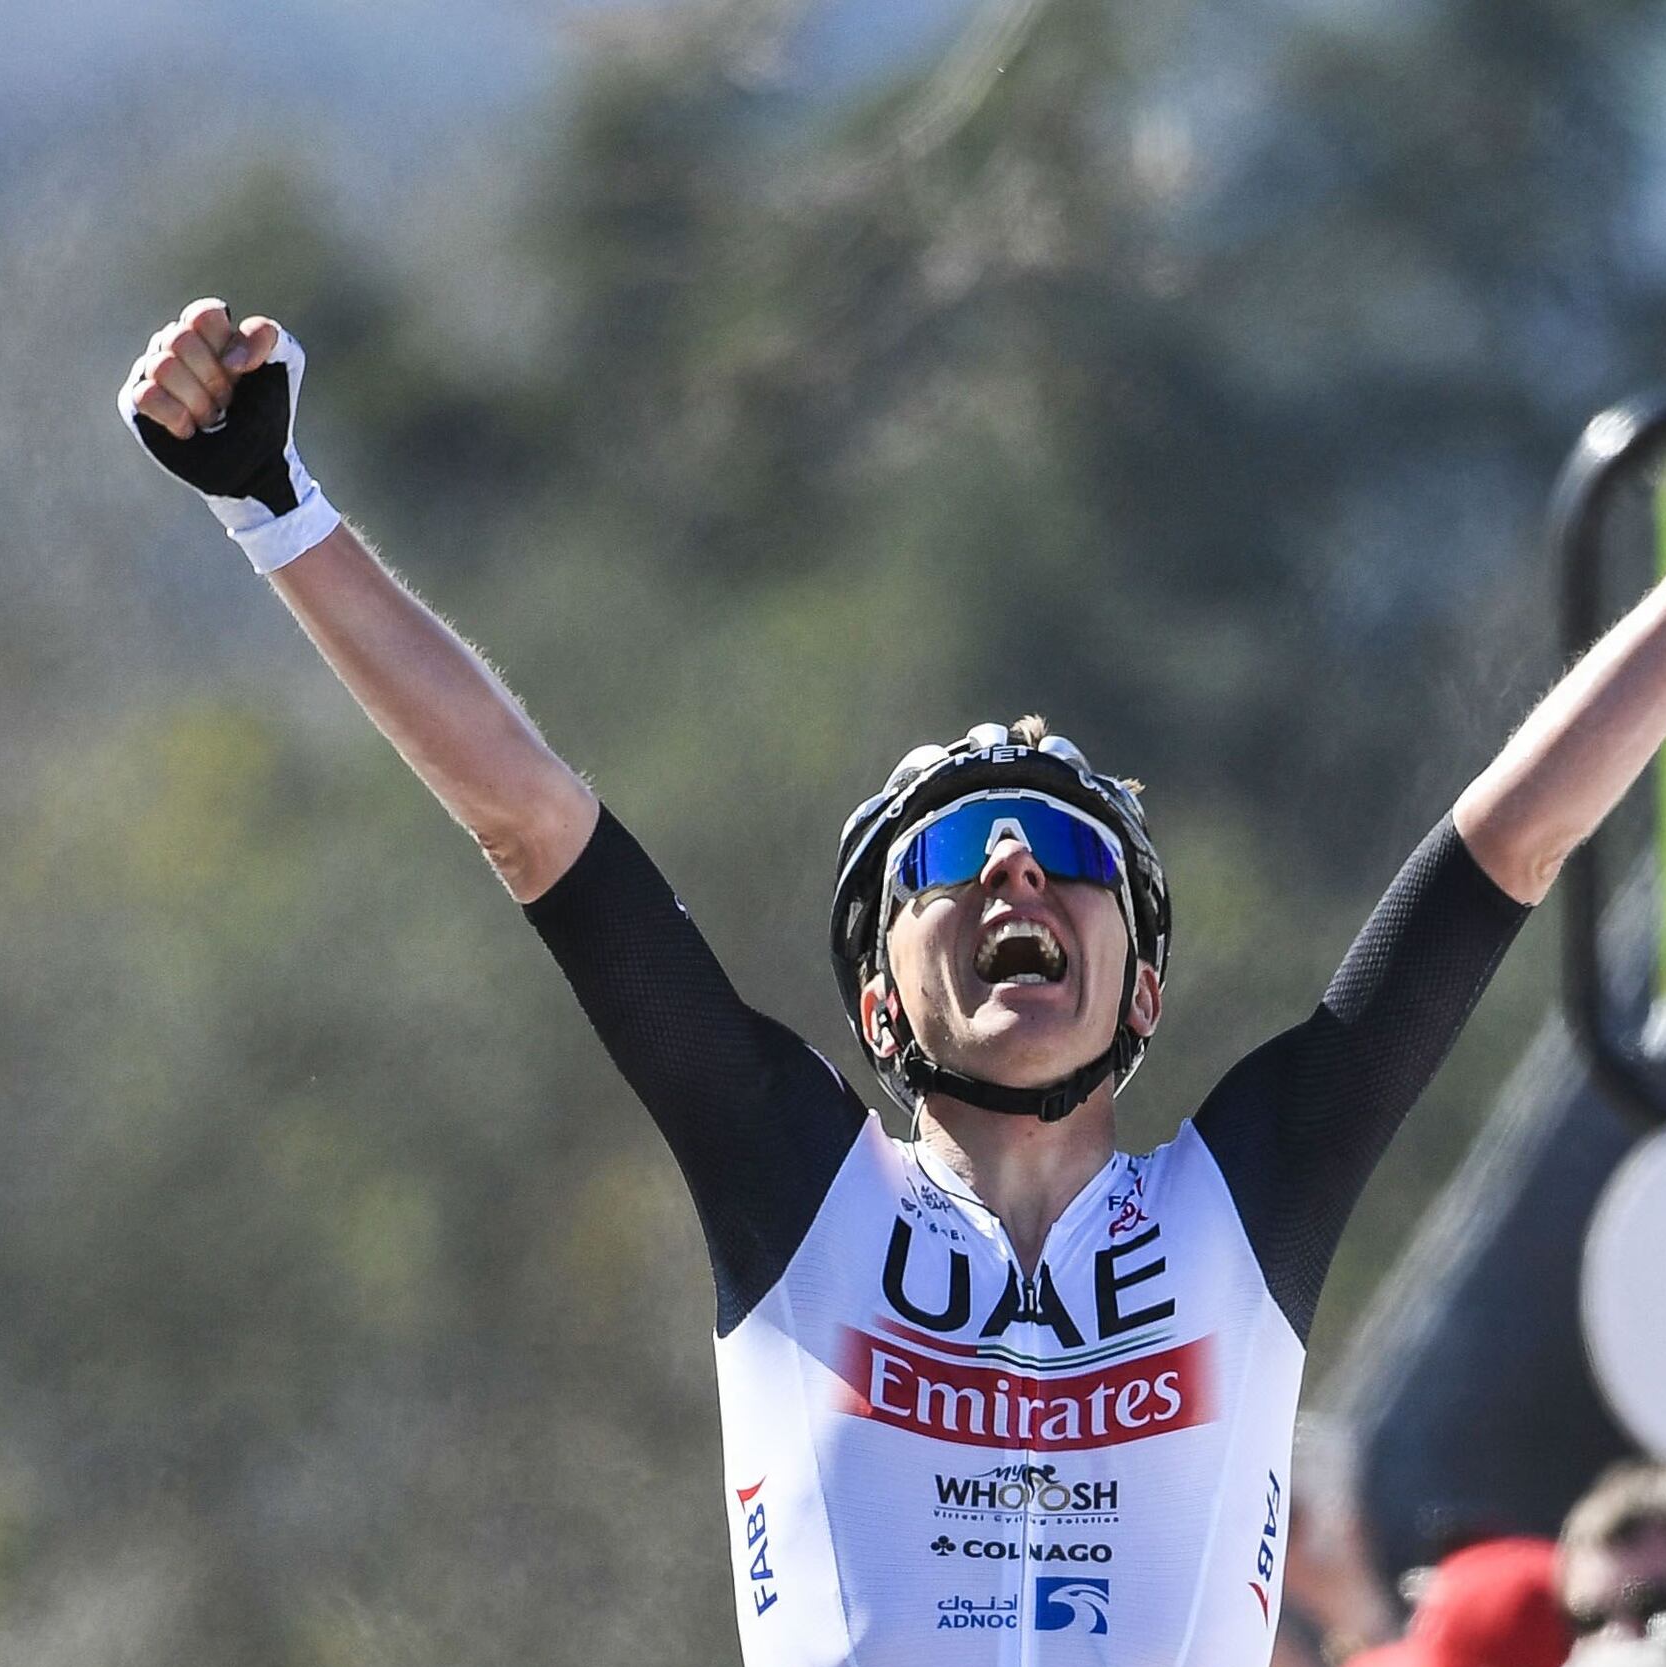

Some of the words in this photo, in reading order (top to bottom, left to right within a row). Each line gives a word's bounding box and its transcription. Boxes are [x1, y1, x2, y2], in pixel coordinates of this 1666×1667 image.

[881, 1215, 1177, 1349] UAE
[869, 1348, 1182, 1441] Emirates
[935, 1474, 1119, 1512] WHOOSH
[1258, 1468, 1281, 1583] FAB
[746, 1502, 779, 1617] FAB
[962, 1539, 1113, 1563] COLNAGO
[937, 1614, 1018, 1629] ADNOC
